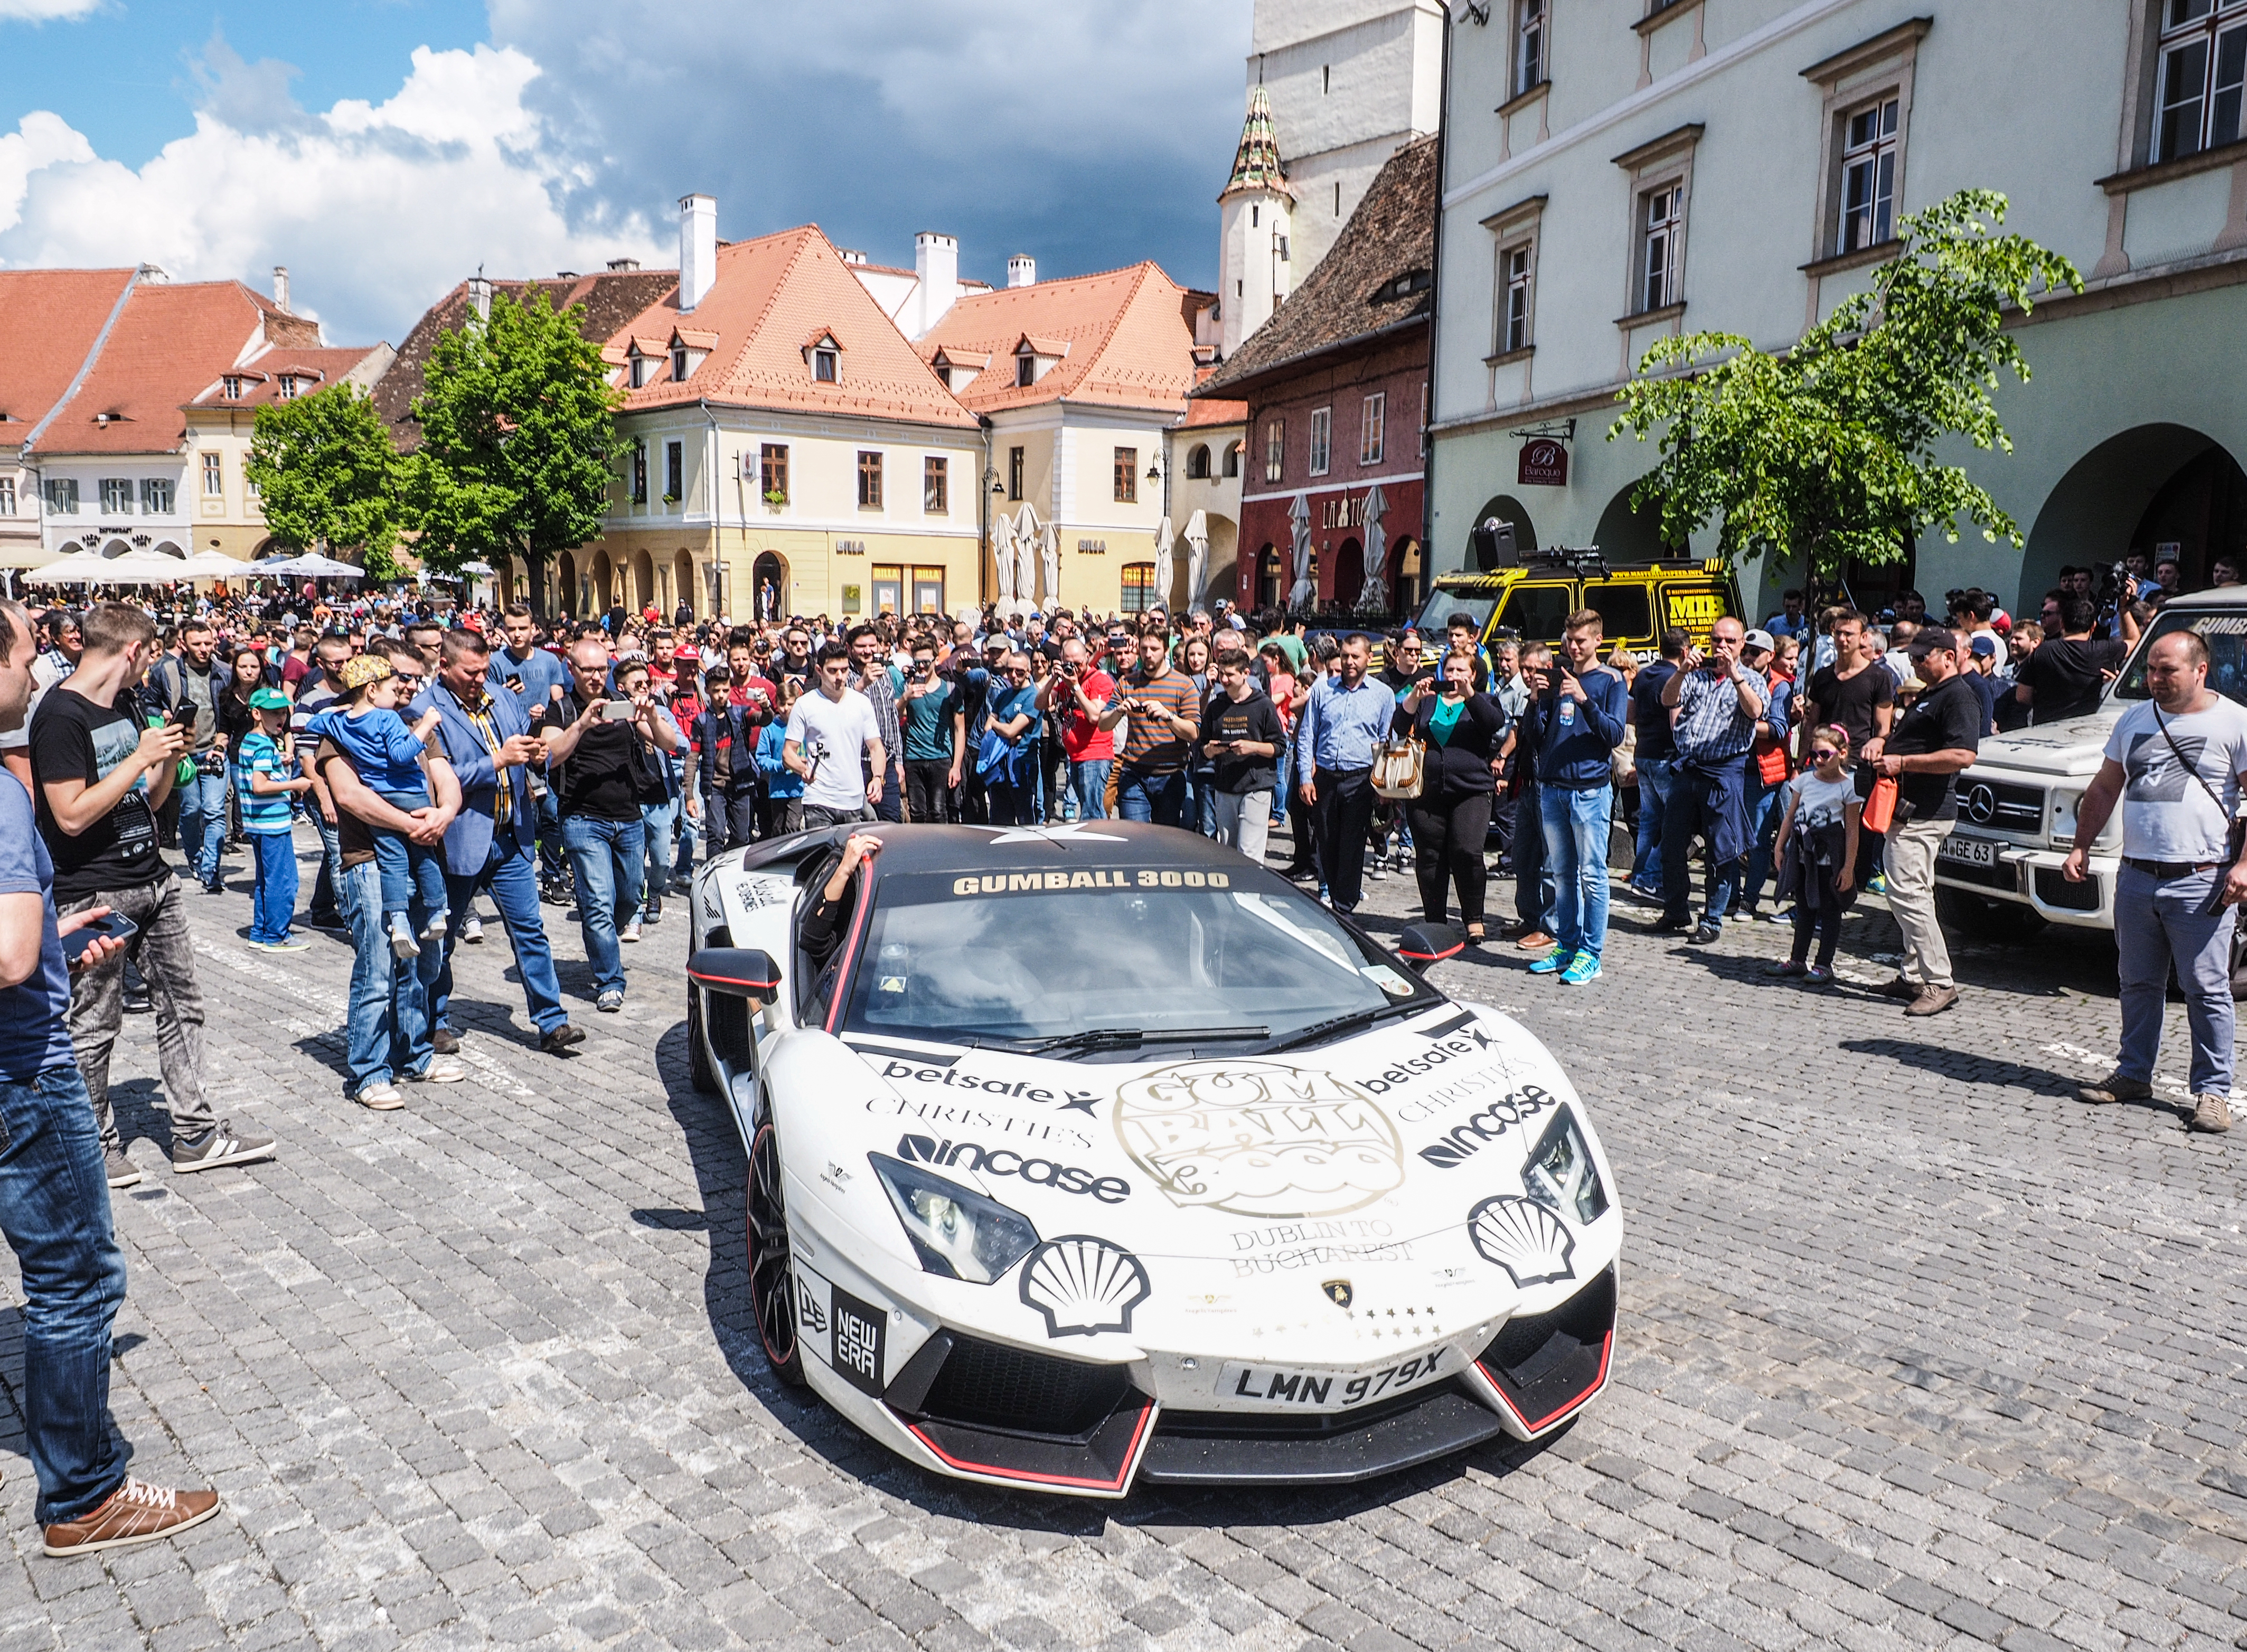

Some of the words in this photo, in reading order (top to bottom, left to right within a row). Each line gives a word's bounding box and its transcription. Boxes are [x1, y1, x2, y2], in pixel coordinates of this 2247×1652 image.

[1525, 465, 1560, 478] Baroque
[1322, 500, 1336, 529] LA
[1351, 497, 1368, 527] TU
[836, 539, 866, 555] BILLA
[1078, 539, 1107, 555] BILLA
[874, 568, 898, 579] BILLA
[916, 569, 940, 580] BILLA
[1669, 595, 1725, 618] MIB
[1670, 618, 1687, 627] MEN
[1956, 840, 1971, 859] GE
[1974, 844, 1989, 862] 63
[953, 871, 1131, 895] GUMBALL
[1137, 870, 1229, 888] 3000
[882, 1062, 1054, 1103] betsafe
[1355, 1039, 1472, 1094] betsafe
[1118, 1071, 1361, 1112] GUM
[866, 1097, 1094, 1149] CHRISTIE'S
[1123, 1103, 1394, 1158] BALL
[1229, 1222, 1348, 1251] DUBLIN
[1351, 1219, 1393, 1237] TO
[1229, 1242, 1414, 1278] BUCHAREST
[838, 1307, 877, 1352] NEW
[838, 1334, 876, 1379] ERA
[1235, 1369, 1332, 1404] LMN
[1342, 1346, 1447, 1405] 979X
